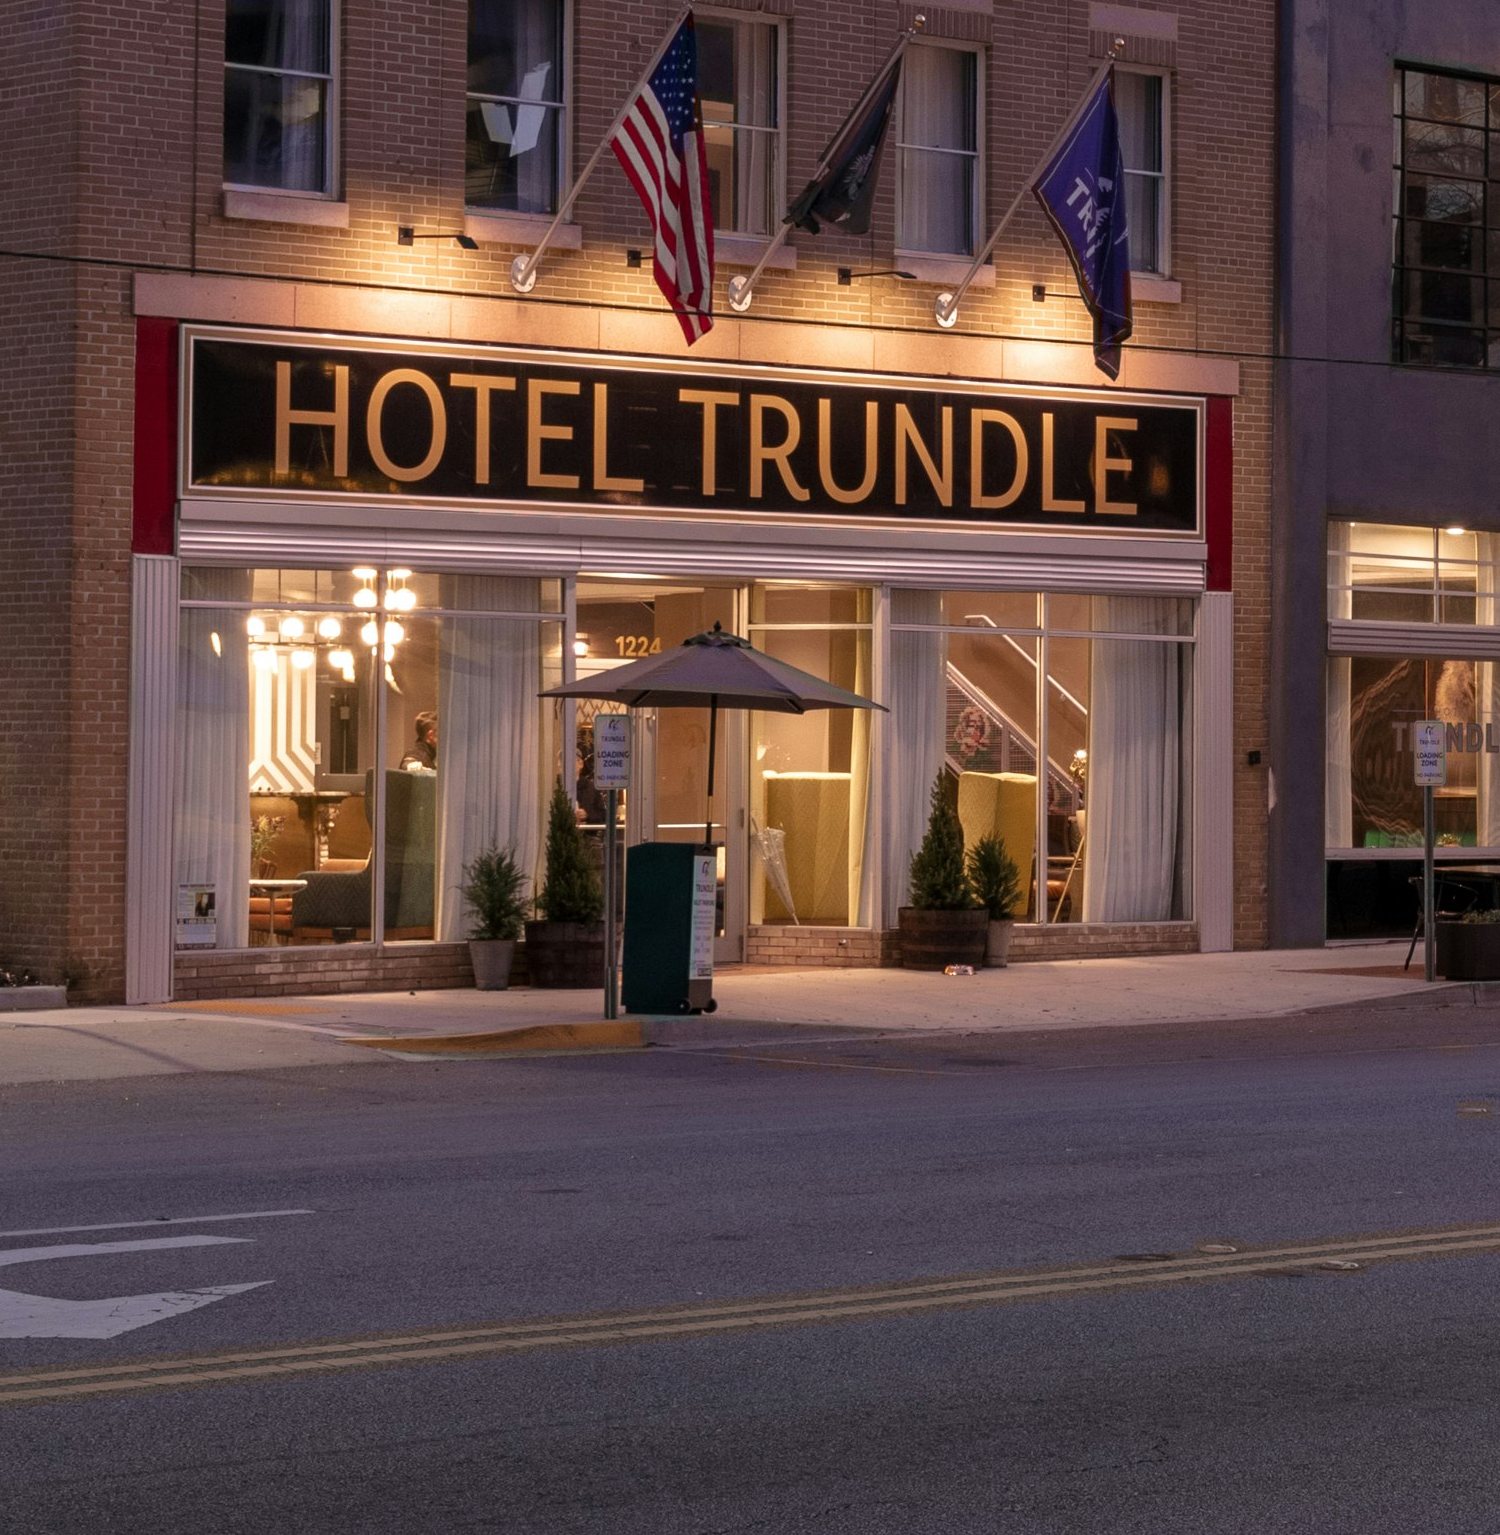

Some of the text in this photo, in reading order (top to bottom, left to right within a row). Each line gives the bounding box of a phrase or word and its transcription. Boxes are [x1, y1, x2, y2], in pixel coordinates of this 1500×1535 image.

[276, 361, 1138, 515] HOTEL TRUNDLE
[615, 635, 662, 657] 1224
[598, 751, 630, 759] LOADING
[603, 760, 624, 768] ZONE
